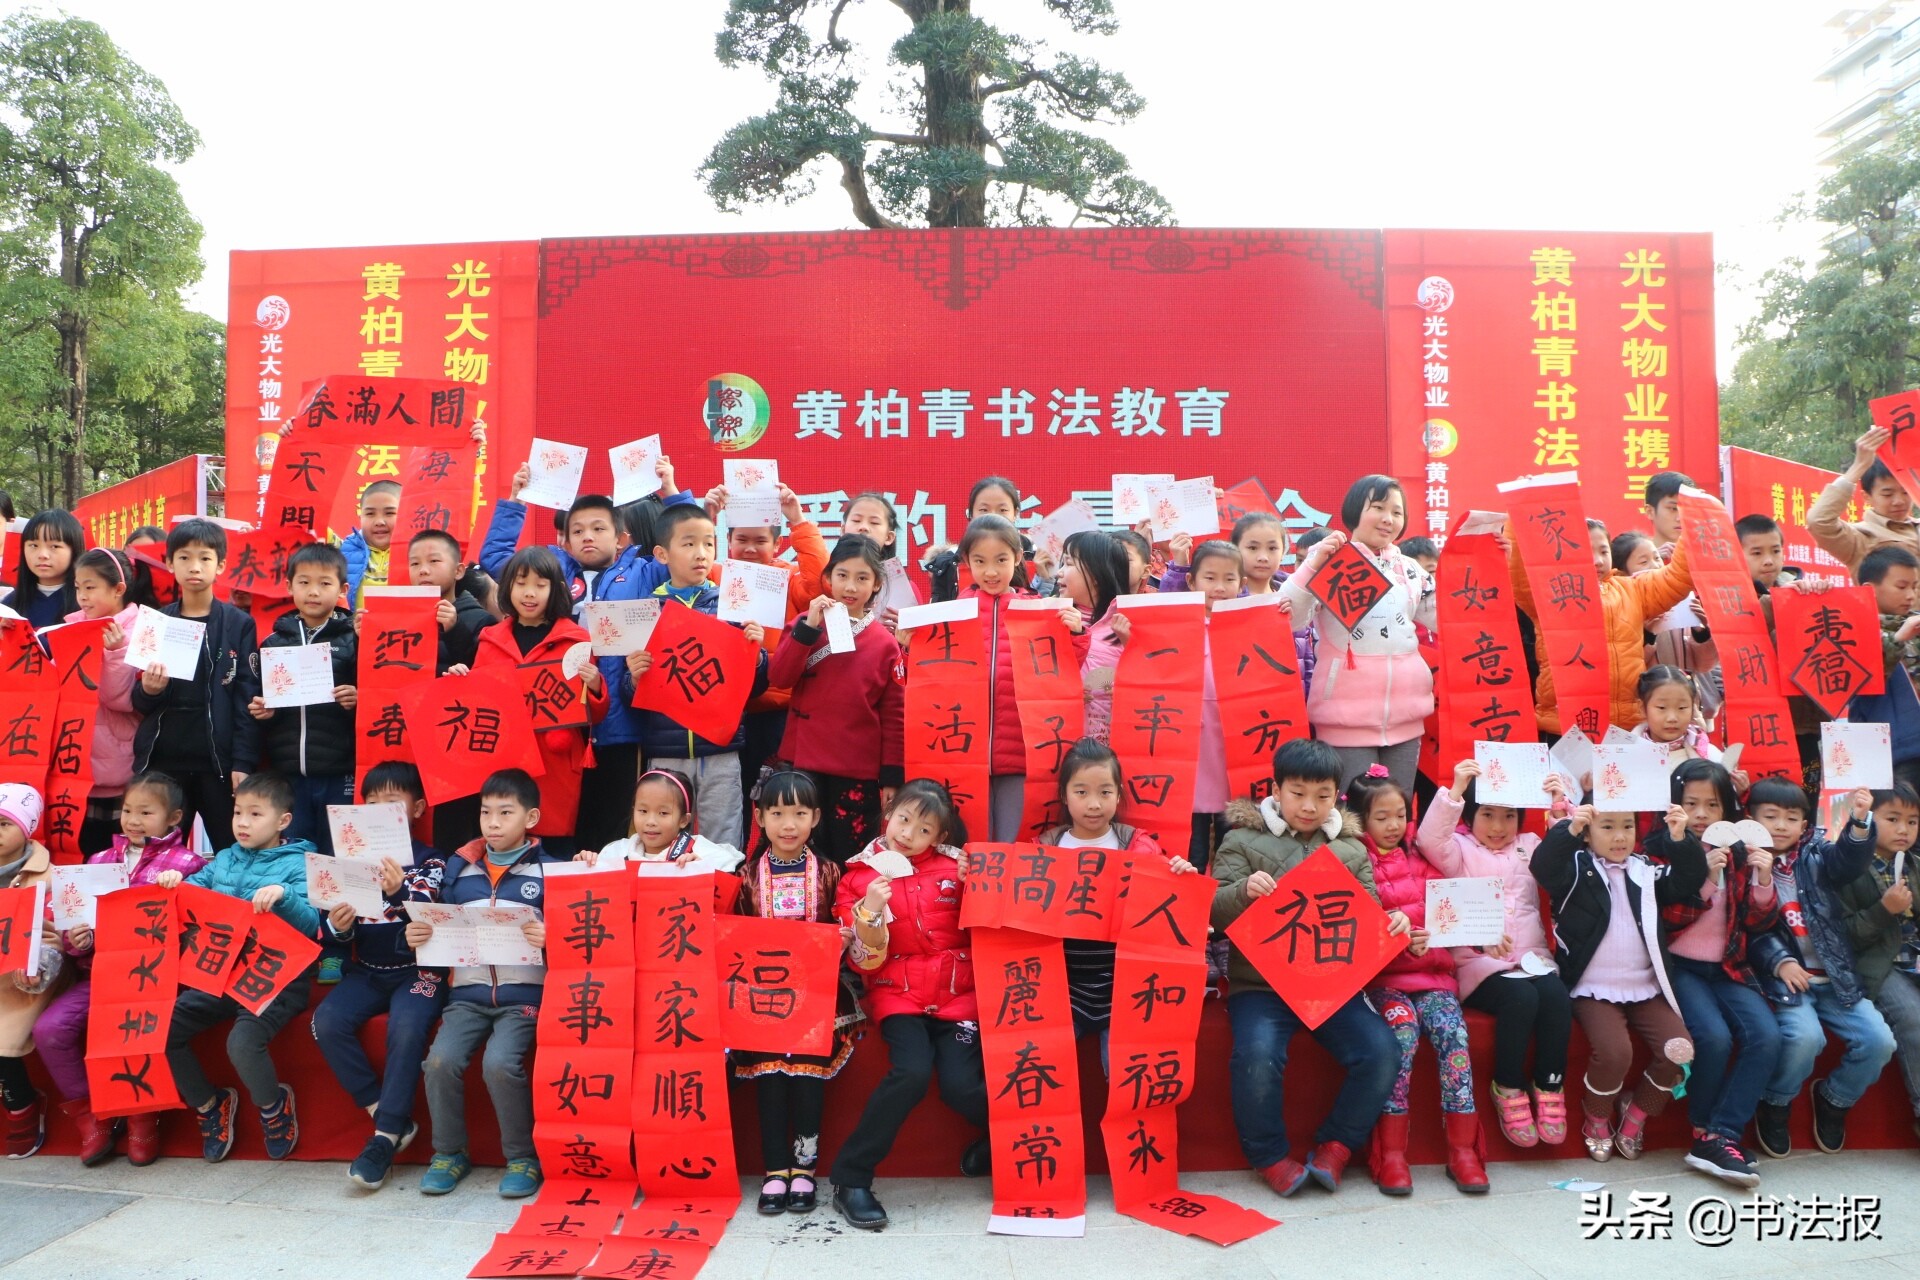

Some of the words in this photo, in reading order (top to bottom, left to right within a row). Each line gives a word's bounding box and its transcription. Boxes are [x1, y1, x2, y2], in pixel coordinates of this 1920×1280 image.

[258, 333, 283, 421] 光大物业
[1423, 315, 1450, 408] 光大物业
[1529, 247, 1580, 470] 黄柏青书法
[792, 386, 1231, 440] 黄柏青书法教育
[1327, 559, 1378, 618] 福
[660, 636, 725, 703] 福
[1694, 517, 1790, 780] 福旺財旺
[1810, 651, 1852, 696] 福
[436, 699, 500, 753] 福
[524, 668, 577, 723] 福
[179, 908, 235, 977] 福
[1258, 889, 1358, 964] 福
[232, 925, 288, 1003] 福
[722, 950, 796, 1019] 福
[995, 956, 1064, 1218] 麗春常
